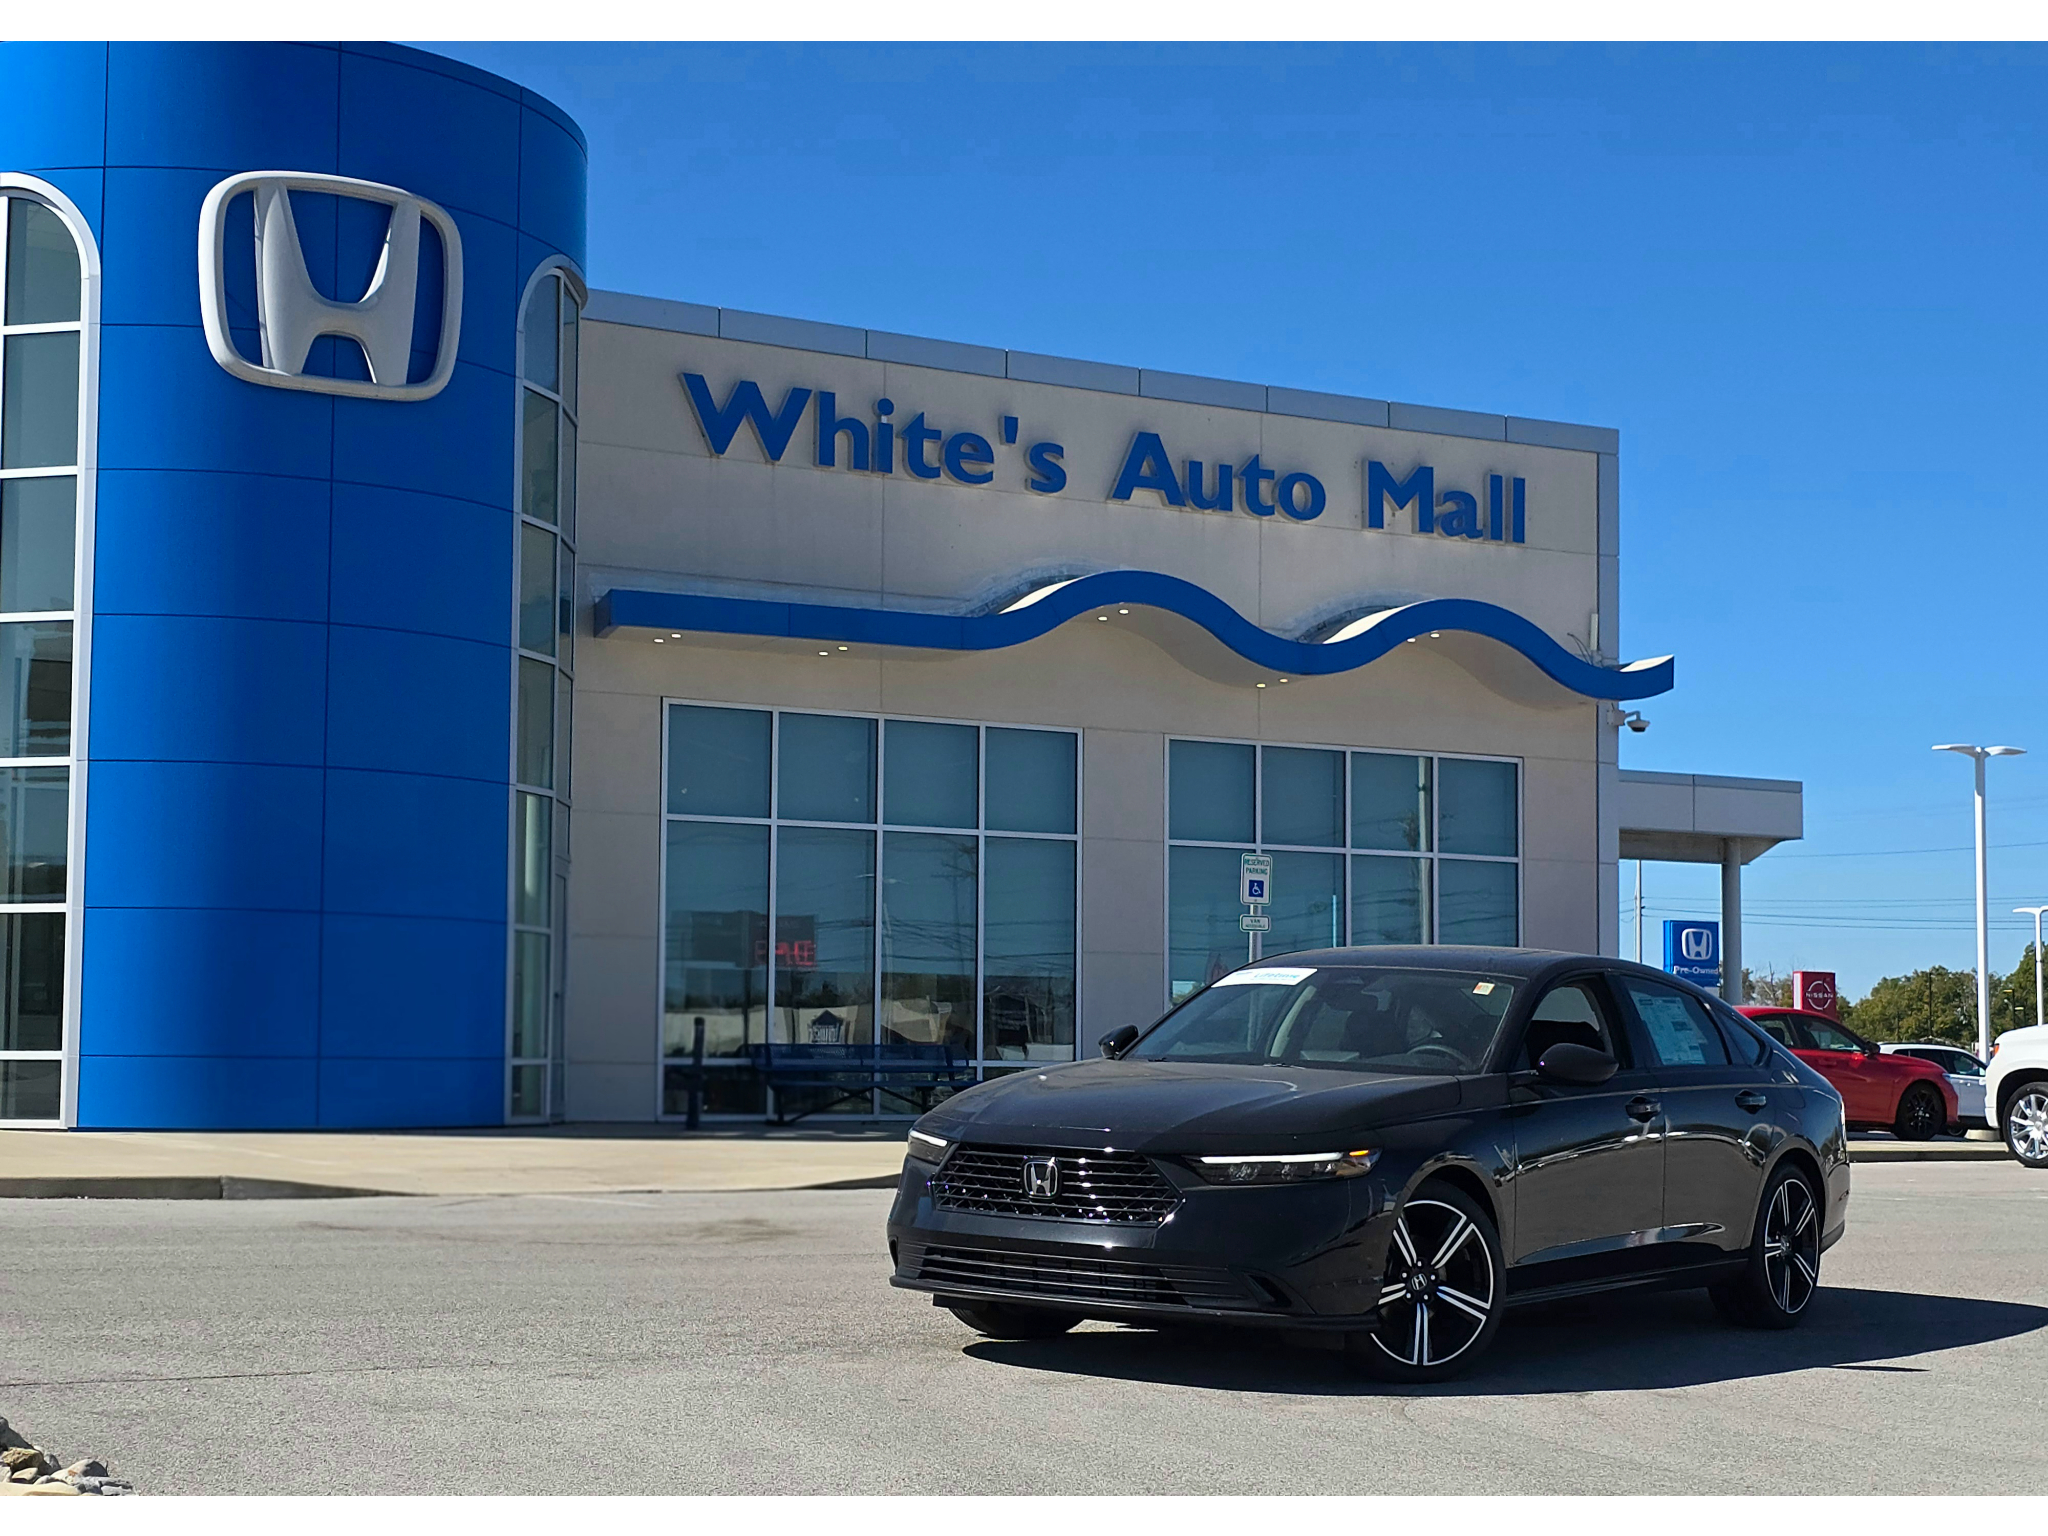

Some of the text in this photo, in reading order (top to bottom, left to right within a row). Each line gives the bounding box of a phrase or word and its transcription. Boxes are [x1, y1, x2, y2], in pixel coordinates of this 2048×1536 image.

[682, 371, 1526, 545] White's Auto Mall
[1244, 858, 1270, 867] RESERVED
[1245, 867, 1268, 875] PARKING
[1673, 965, 1719, 975] Pre-Owned
[1805, 991, 1834, 999] NISSAN
